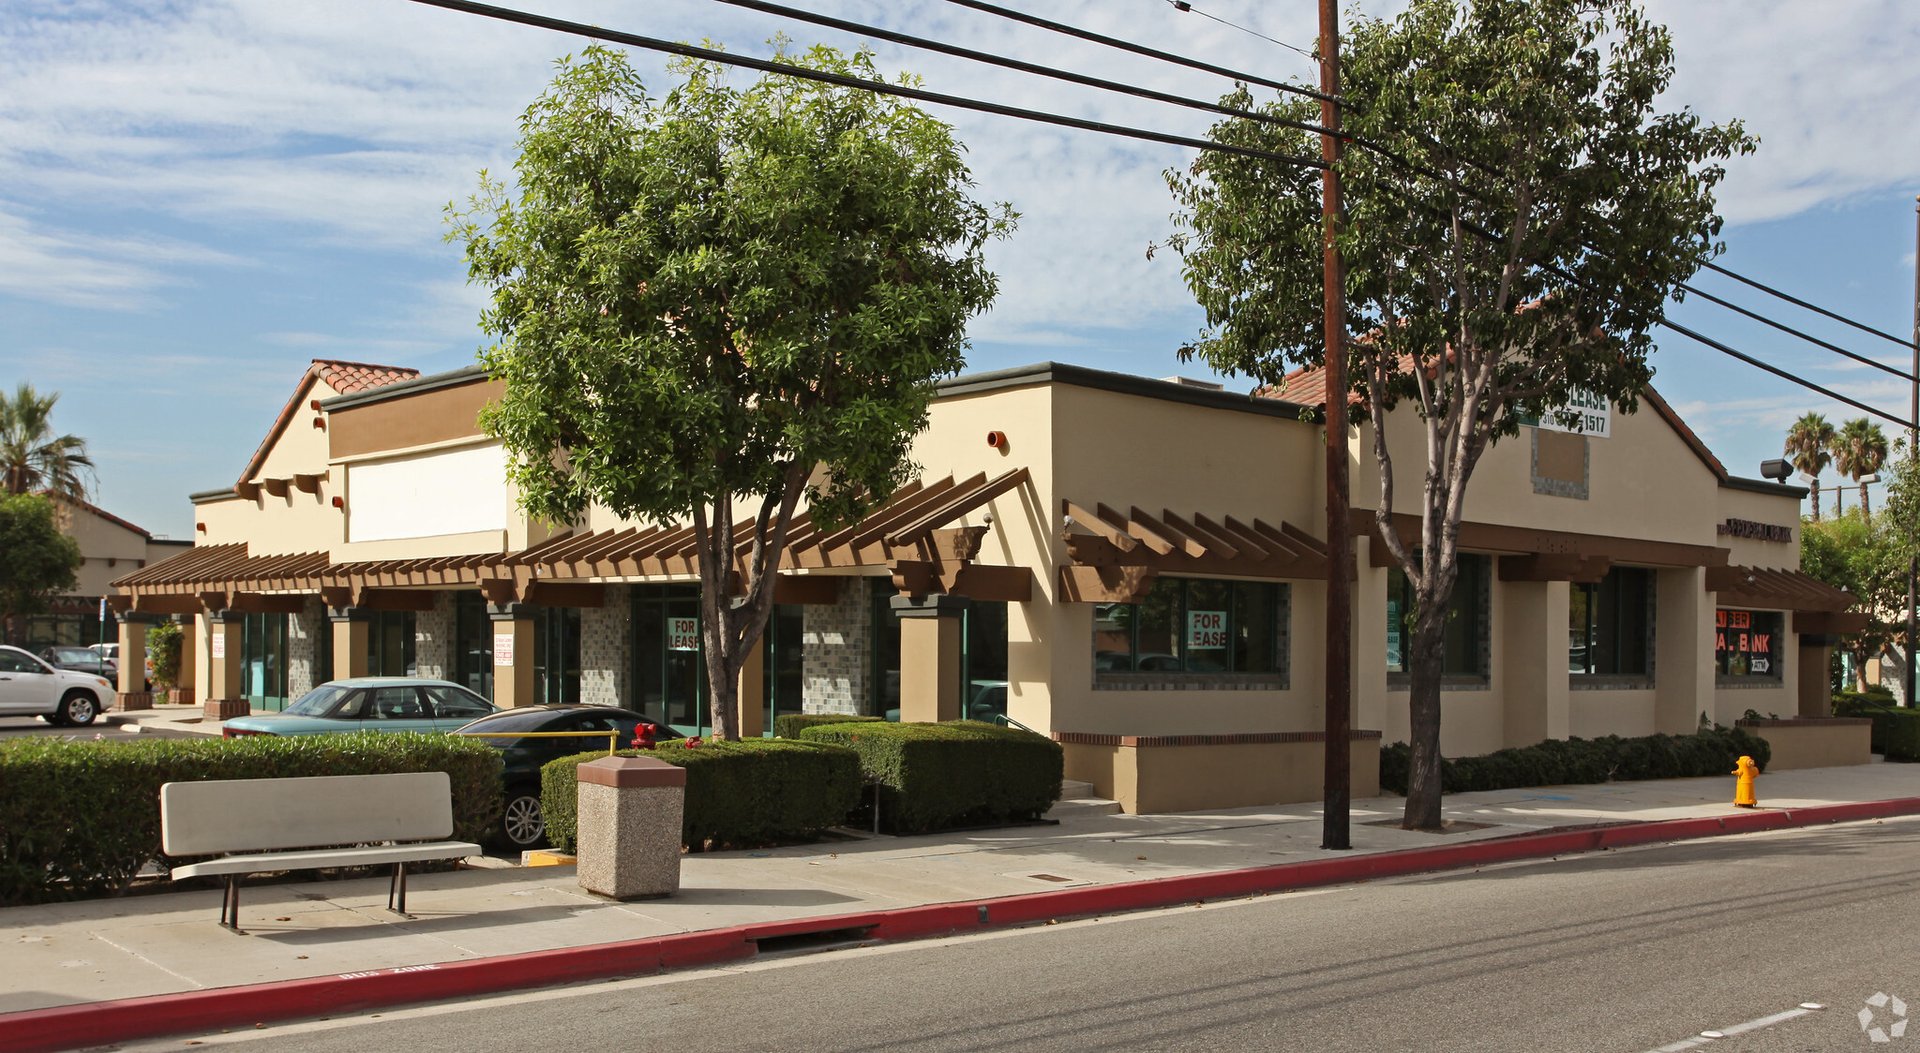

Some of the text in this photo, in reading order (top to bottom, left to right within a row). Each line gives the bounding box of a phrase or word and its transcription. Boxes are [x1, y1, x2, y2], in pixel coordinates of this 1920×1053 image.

[1542, 413, 1554, 425] 310
[675, 620, 695, 633] FOR
[1193, 614, 1221, 629] FOR
[339, 964, 441, 980] BUS ZONE
